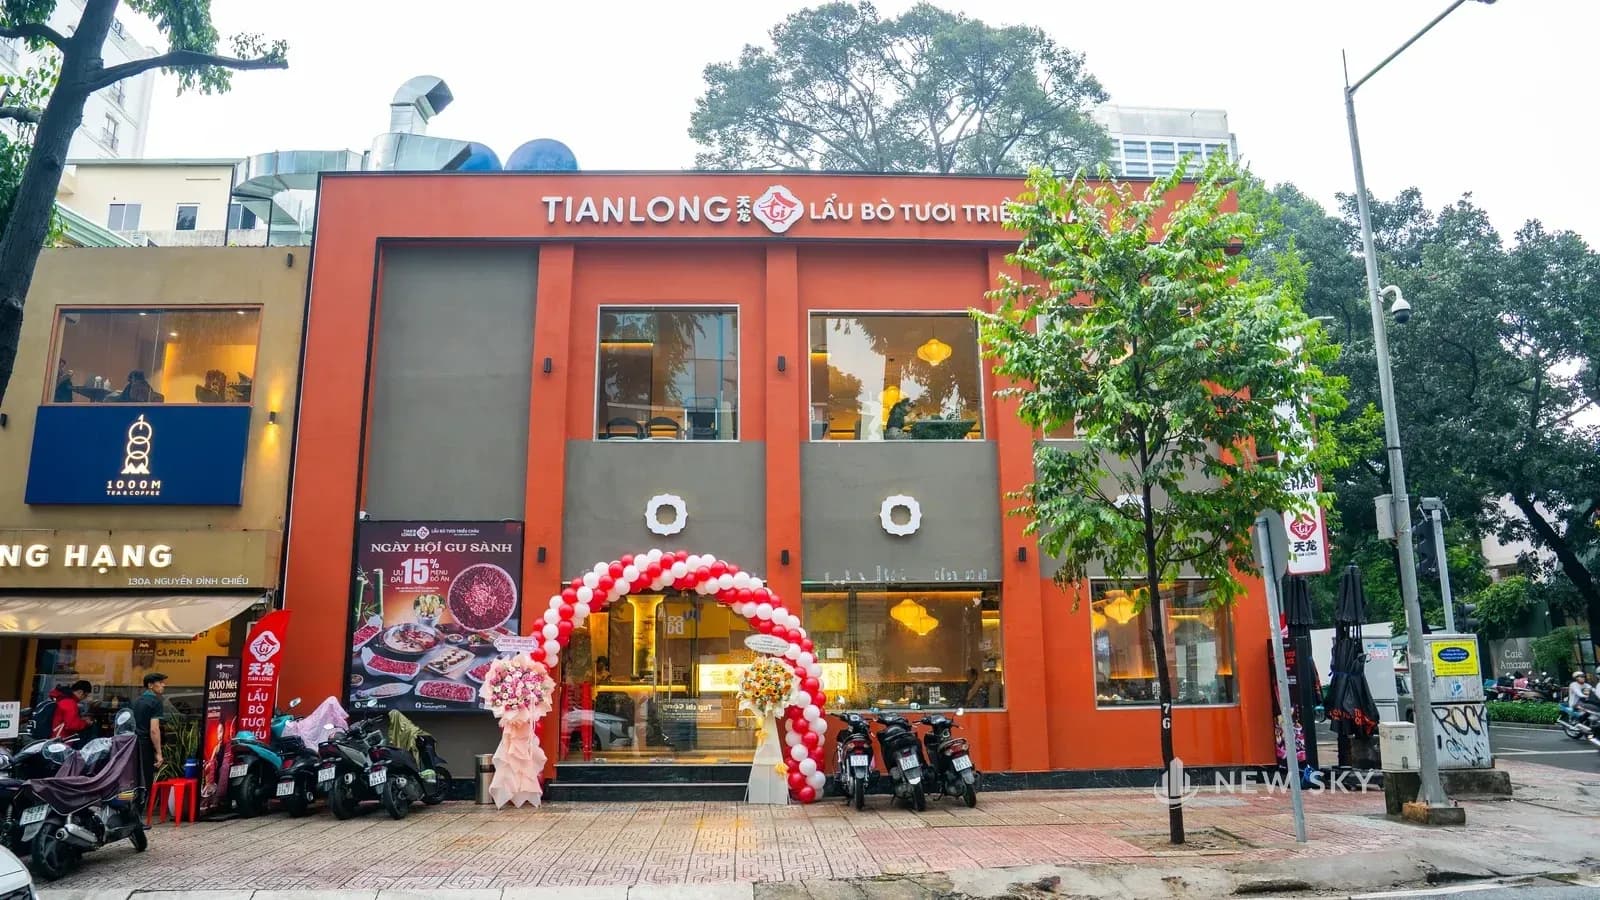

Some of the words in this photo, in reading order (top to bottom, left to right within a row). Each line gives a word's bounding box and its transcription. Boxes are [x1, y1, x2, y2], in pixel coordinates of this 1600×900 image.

[541, 195, 731, 223] TIANLONG
[810, 193, 853, 221] LẨU
[861, 198, 896, 221] BÒ
[900, 201, 956, 222] TƯƠI
[106, 480, 161, 489] 1000M
[371, 541, 411, 553] NGÀY
[415, 541, 441, 554] HỘI
[444, 543, 466, 553] GU
[470, 541, 513, 553] SÀNH
[64, 544, 173, 574] HẠNG
[128, 577, 151, 585] 130A
[248, 662, 275, 676] 天龙
[1500, 660, 1532, 669] Amazon
[248, 687, 268, 702] LẨU
[248, 702, 264, 714] BÒ
